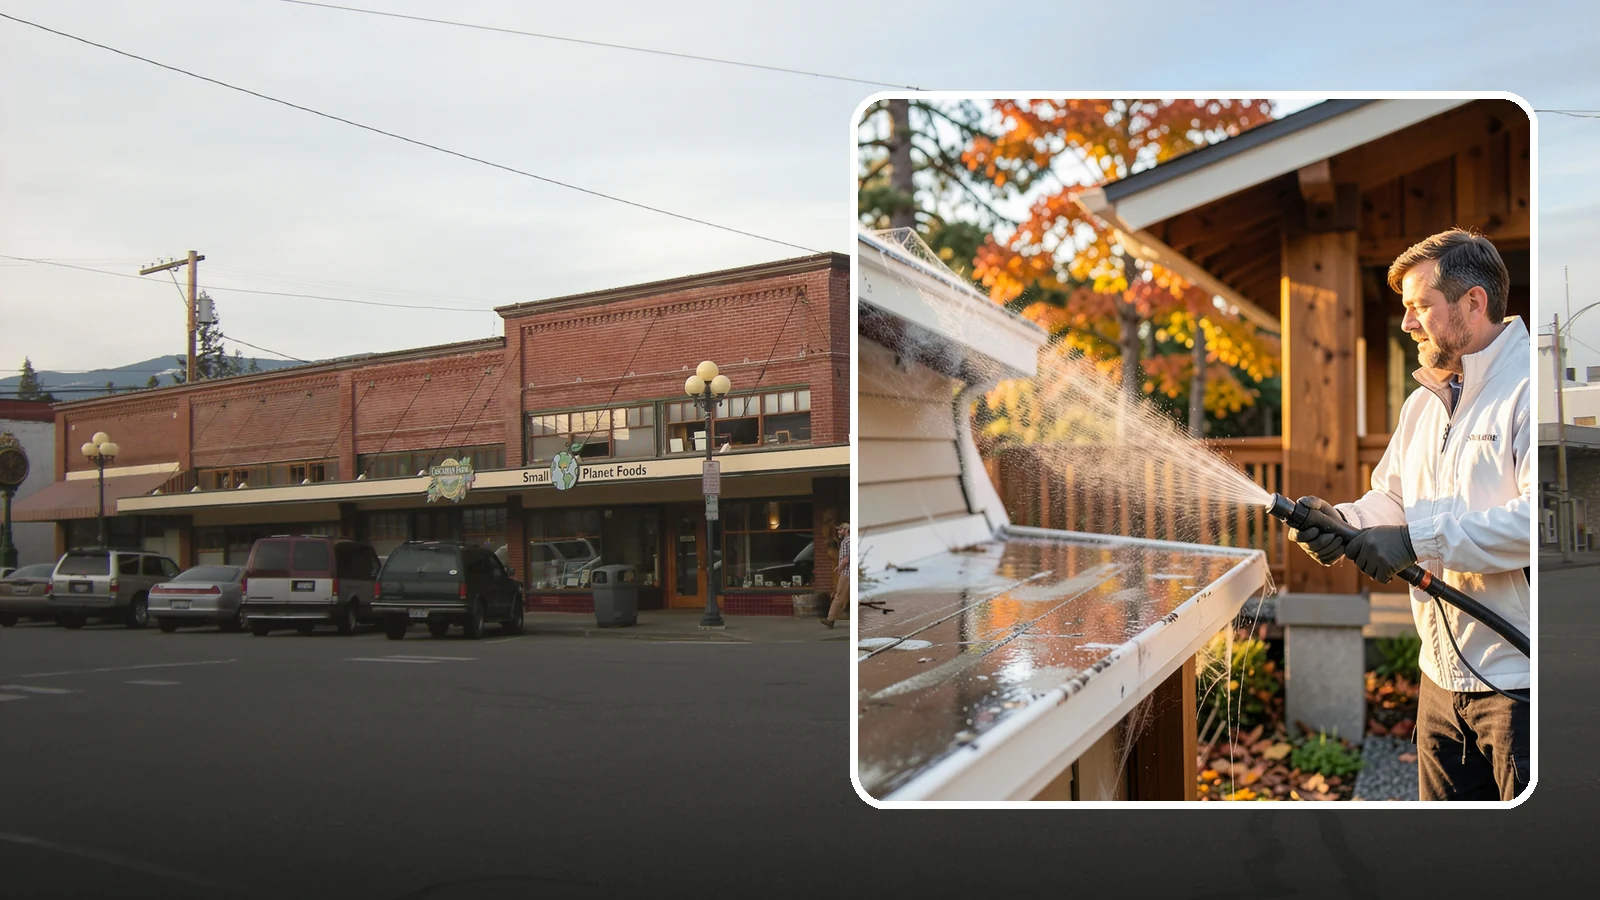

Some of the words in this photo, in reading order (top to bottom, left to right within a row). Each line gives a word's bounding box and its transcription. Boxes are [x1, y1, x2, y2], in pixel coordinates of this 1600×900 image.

[523, 470, 549, 483] Small
[583, 467, 614, 480] Planet
[617, 464, 647, 477] Foods
